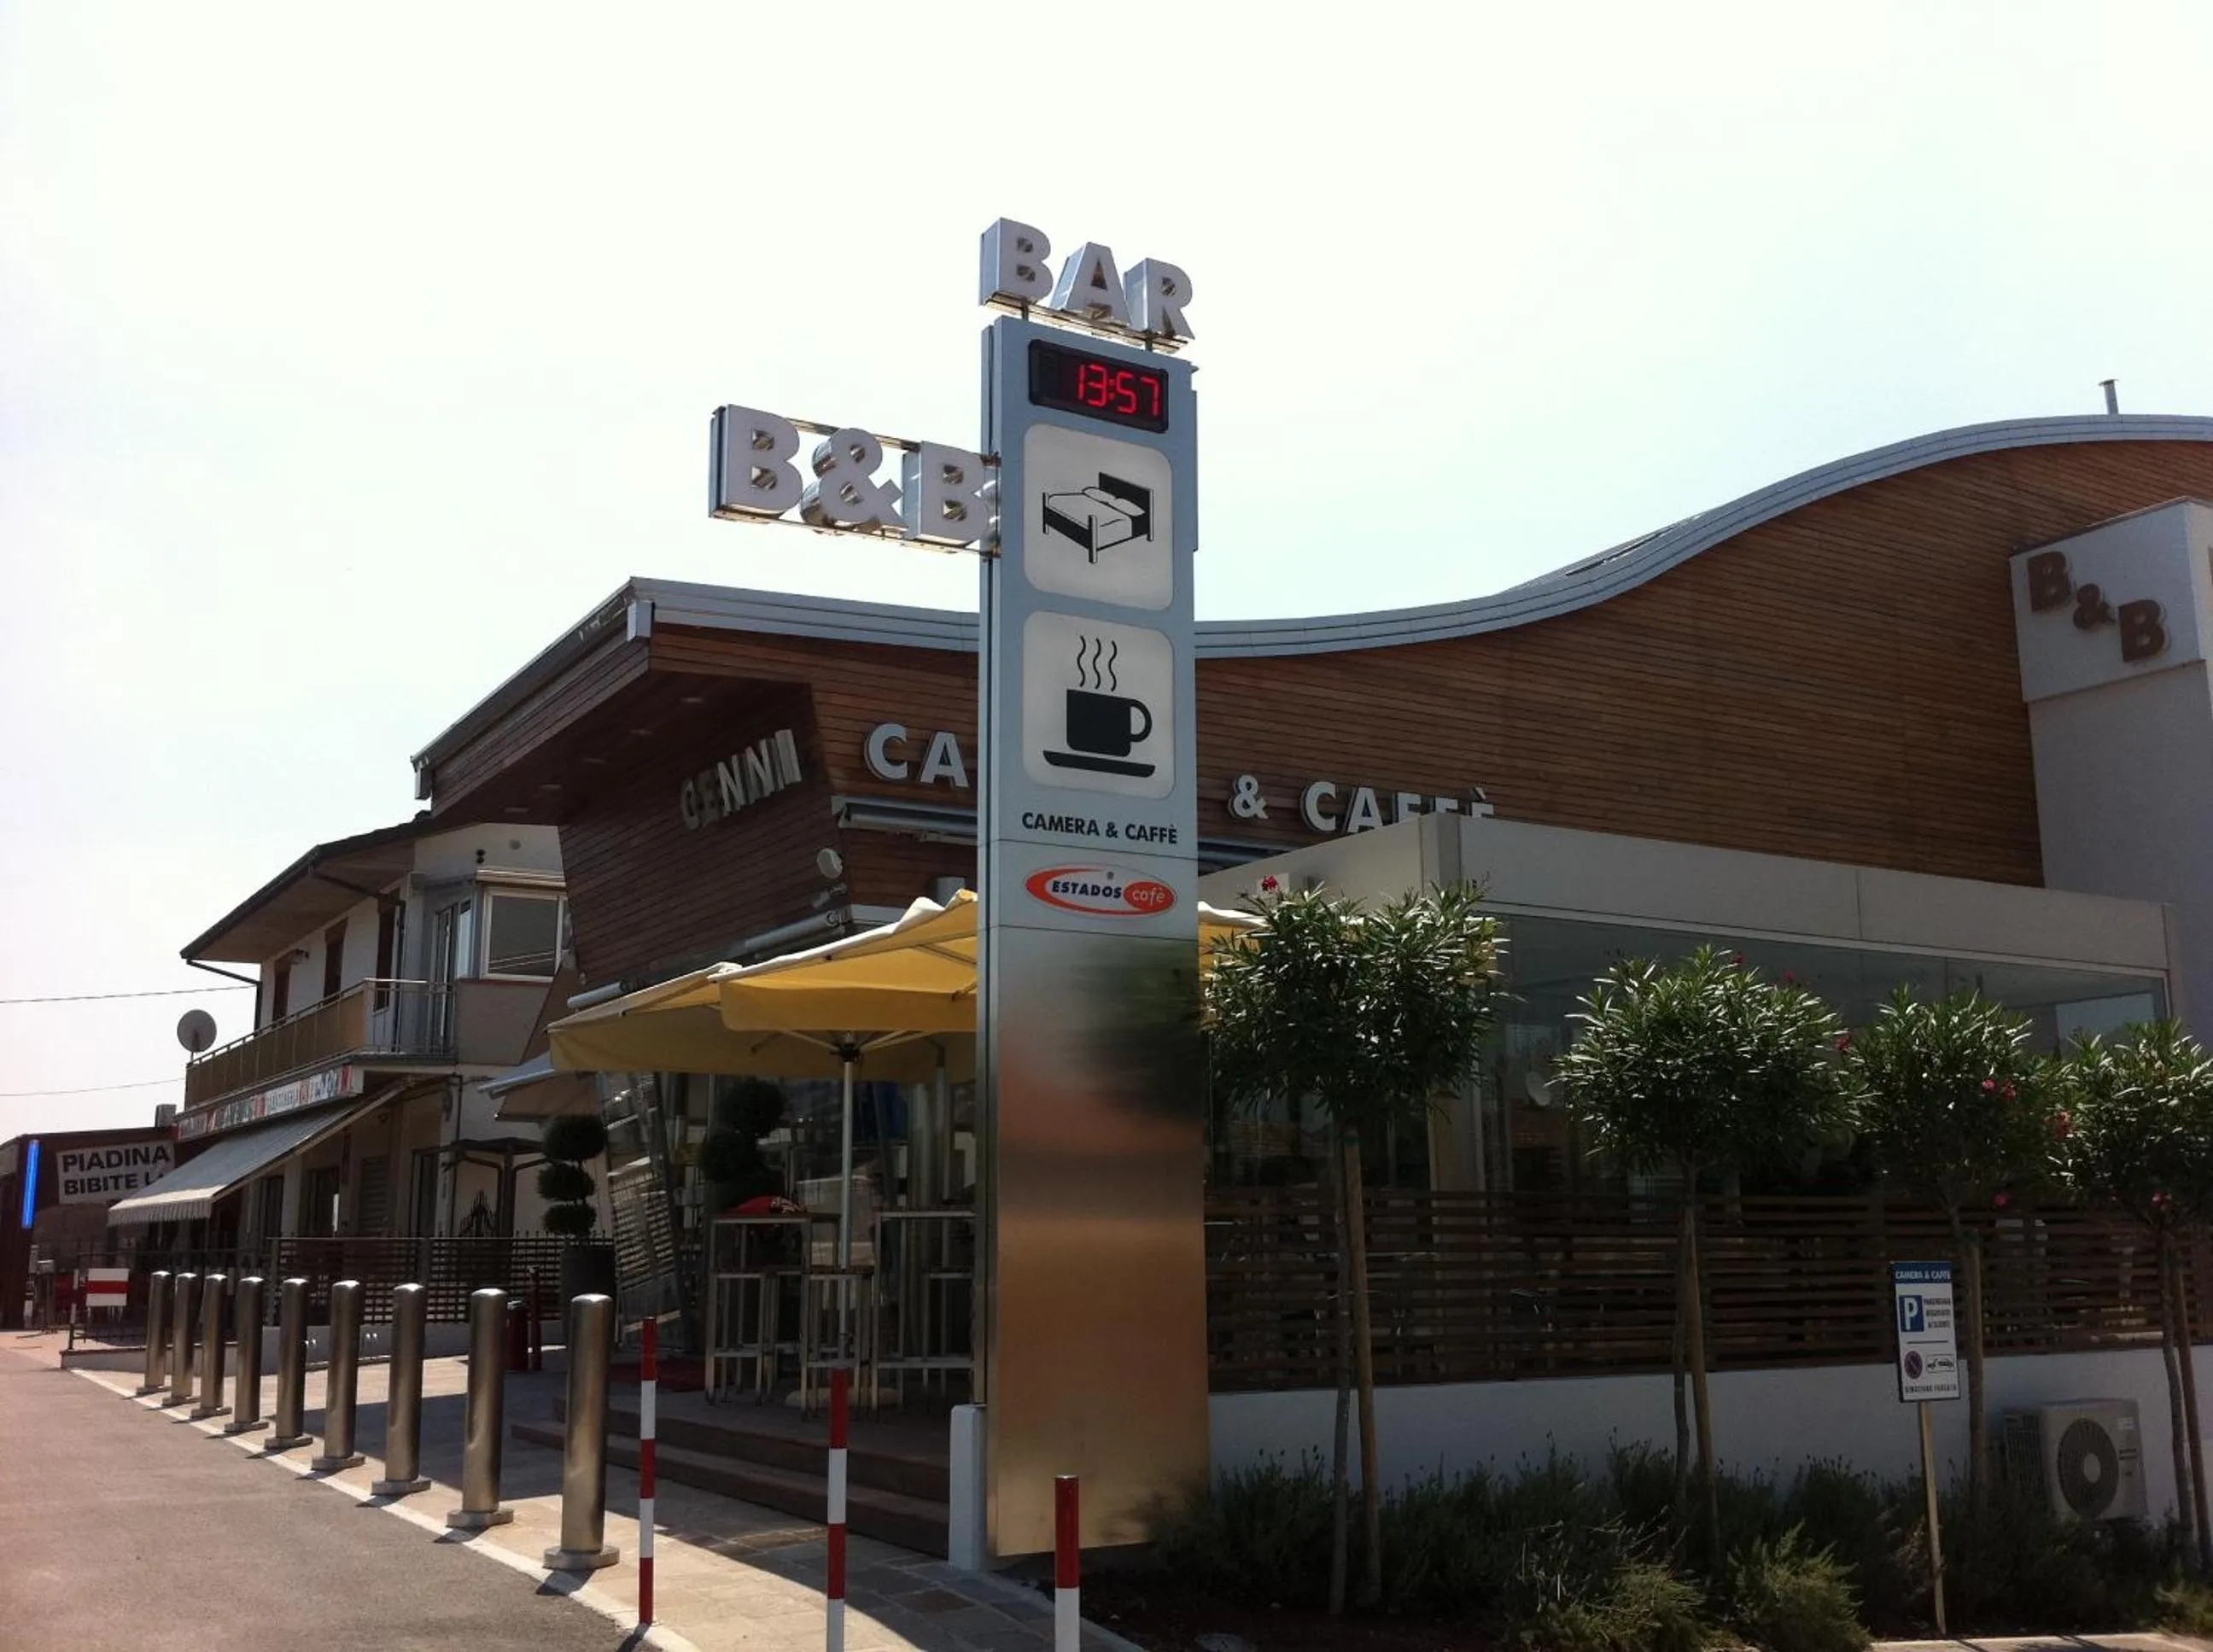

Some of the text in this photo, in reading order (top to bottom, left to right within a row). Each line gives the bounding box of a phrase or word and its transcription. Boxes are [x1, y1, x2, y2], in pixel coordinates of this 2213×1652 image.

[980, 217, 1195, 340] BAR
[1076, 363, 1161, 417] 13:57
[710, 404, 990, 543] B&B
[2028, 552, 2165, 663] B&B
[680, 728, 803, 832] GENNI
[1229, 774, 1269, 820] &
[1022, 812, 1178, 844] CAMERA & CAFFÈ
[1051, 880, 1122, 899] ESTADOS
[62, 1145, 170, 1172] PIADINA
[64, 1173, 138, 1195] BIBITE
[1904, 1297, 1918, 1330] P
